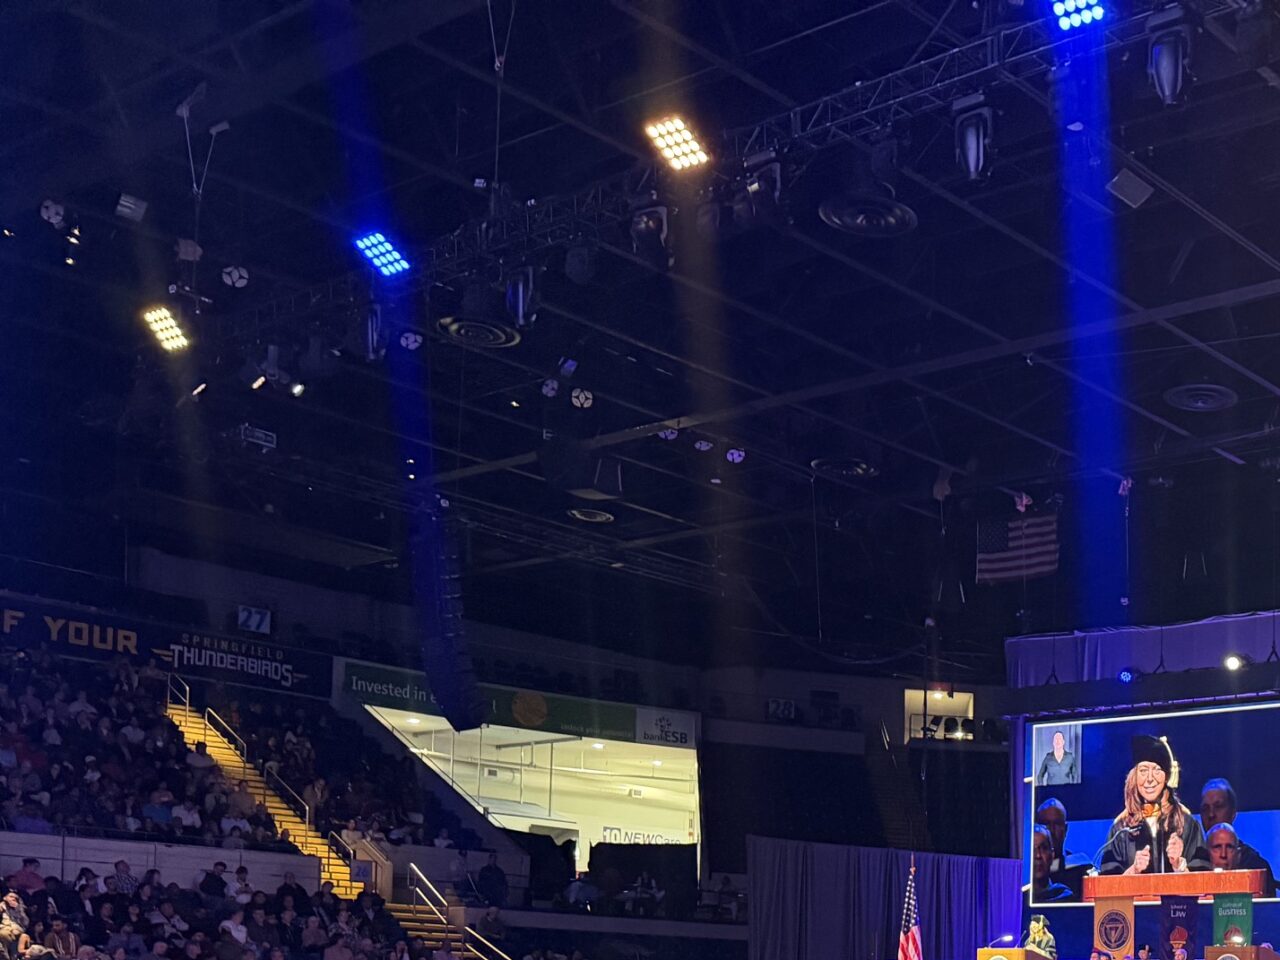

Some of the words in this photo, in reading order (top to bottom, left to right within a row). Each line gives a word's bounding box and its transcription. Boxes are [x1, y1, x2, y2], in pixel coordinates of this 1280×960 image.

[241, 607, 268, 631] 27
[43, 615, 139, 655] YOUR
[182, 633, 284, 660] SPRINGFIELD
[170, 644, 293, 687] THUNDERBIRDS
[351, 676, 410, 699] Invested
[414, 686, 427, 701] in
[1170, 909, 1187, 918] Law
[1218, 907, 1247, 916] Business
